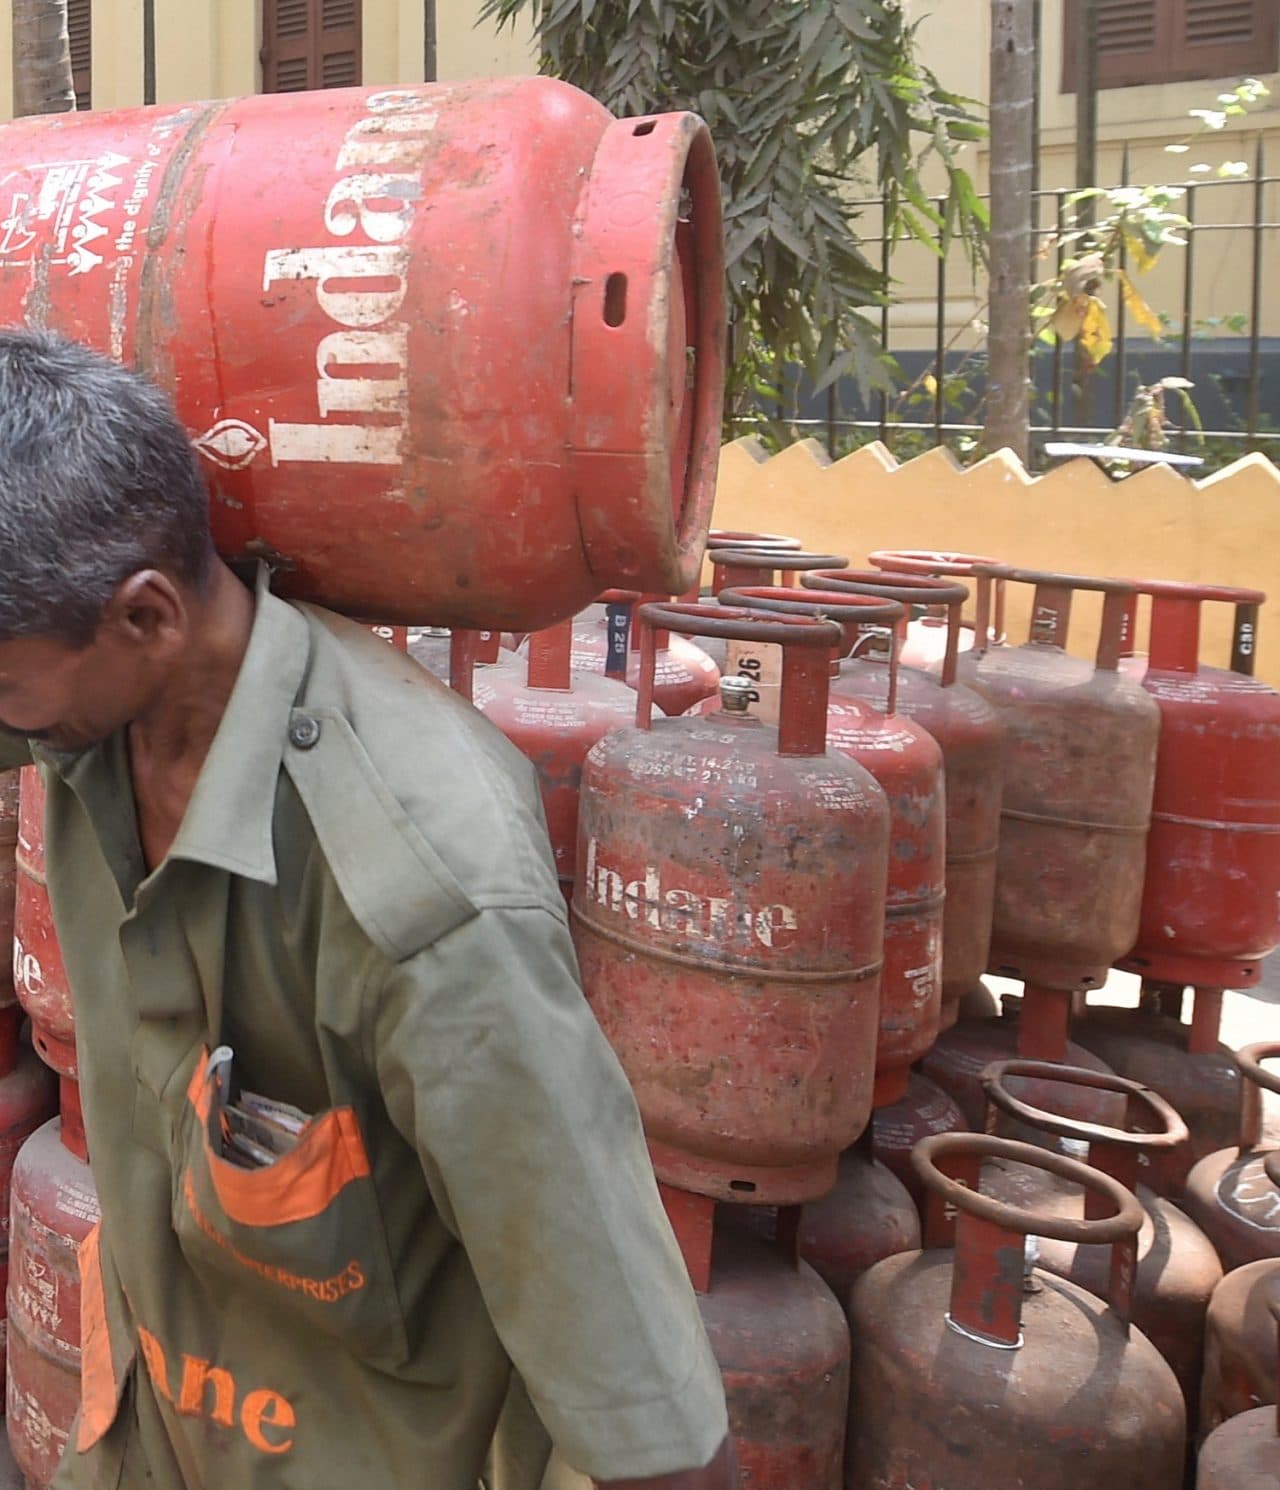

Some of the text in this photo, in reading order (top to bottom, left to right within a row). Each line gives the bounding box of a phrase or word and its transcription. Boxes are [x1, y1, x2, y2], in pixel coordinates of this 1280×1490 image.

[123, 161, 157, 216] dignity
[115, 221, 136, 251] the
[263, 88, 440, 468] Indane
[738, 658, 761, 682] 26
[586, 836, 798, 948] Indane
